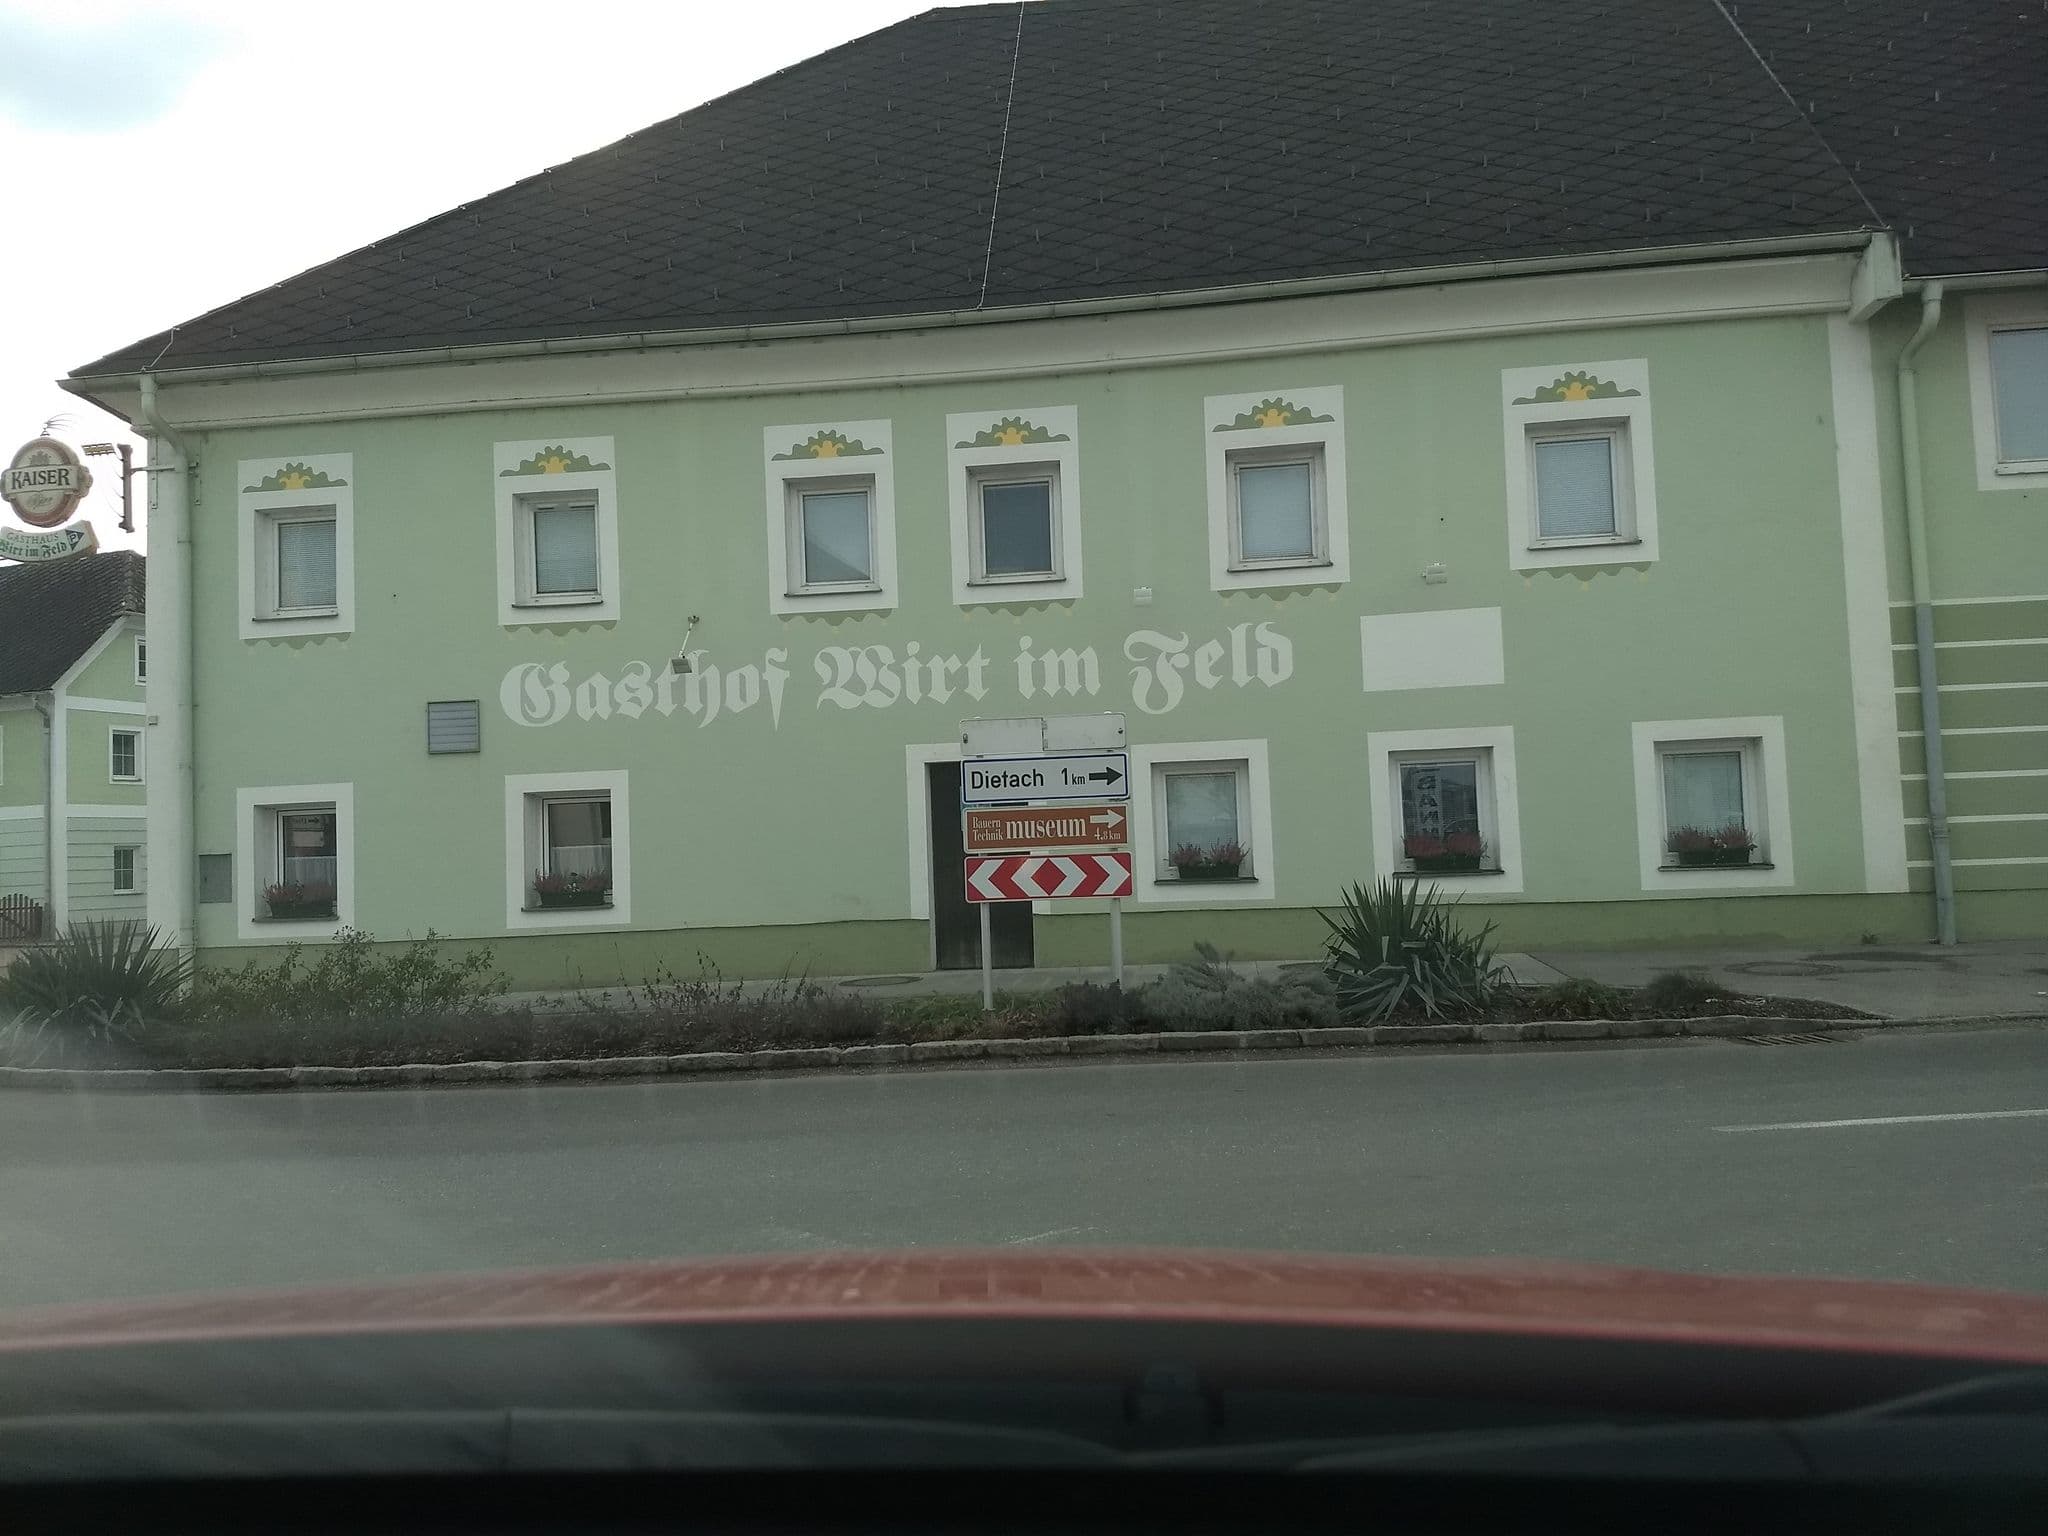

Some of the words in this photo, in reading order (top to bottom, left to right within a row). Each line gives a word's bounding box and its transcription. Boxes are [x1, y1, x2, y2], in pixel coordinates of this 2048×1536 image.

[11, 468, 70, 490] KAISER
[7, 532, 59, 545] GASTHAUS
[26, 544, 39, 557] im
[41, 541, 67, 558] Feld
[500, 647, 790, 732] Gasthof
[814, 640, 991, 710] Wirt
[1013, 635, 1101, 700] im
[1123, 622, 1293, 715] Feld
[971, 768, 1044, 789] Dietach
[1061, 767, 1068, 785] 1
[1071, 773, 1086, 786] km
[972, 816, 1001, 829] Bauern
[1006, 818, 1087, 839] museum
[972, 829, 1004, 841] Technik
